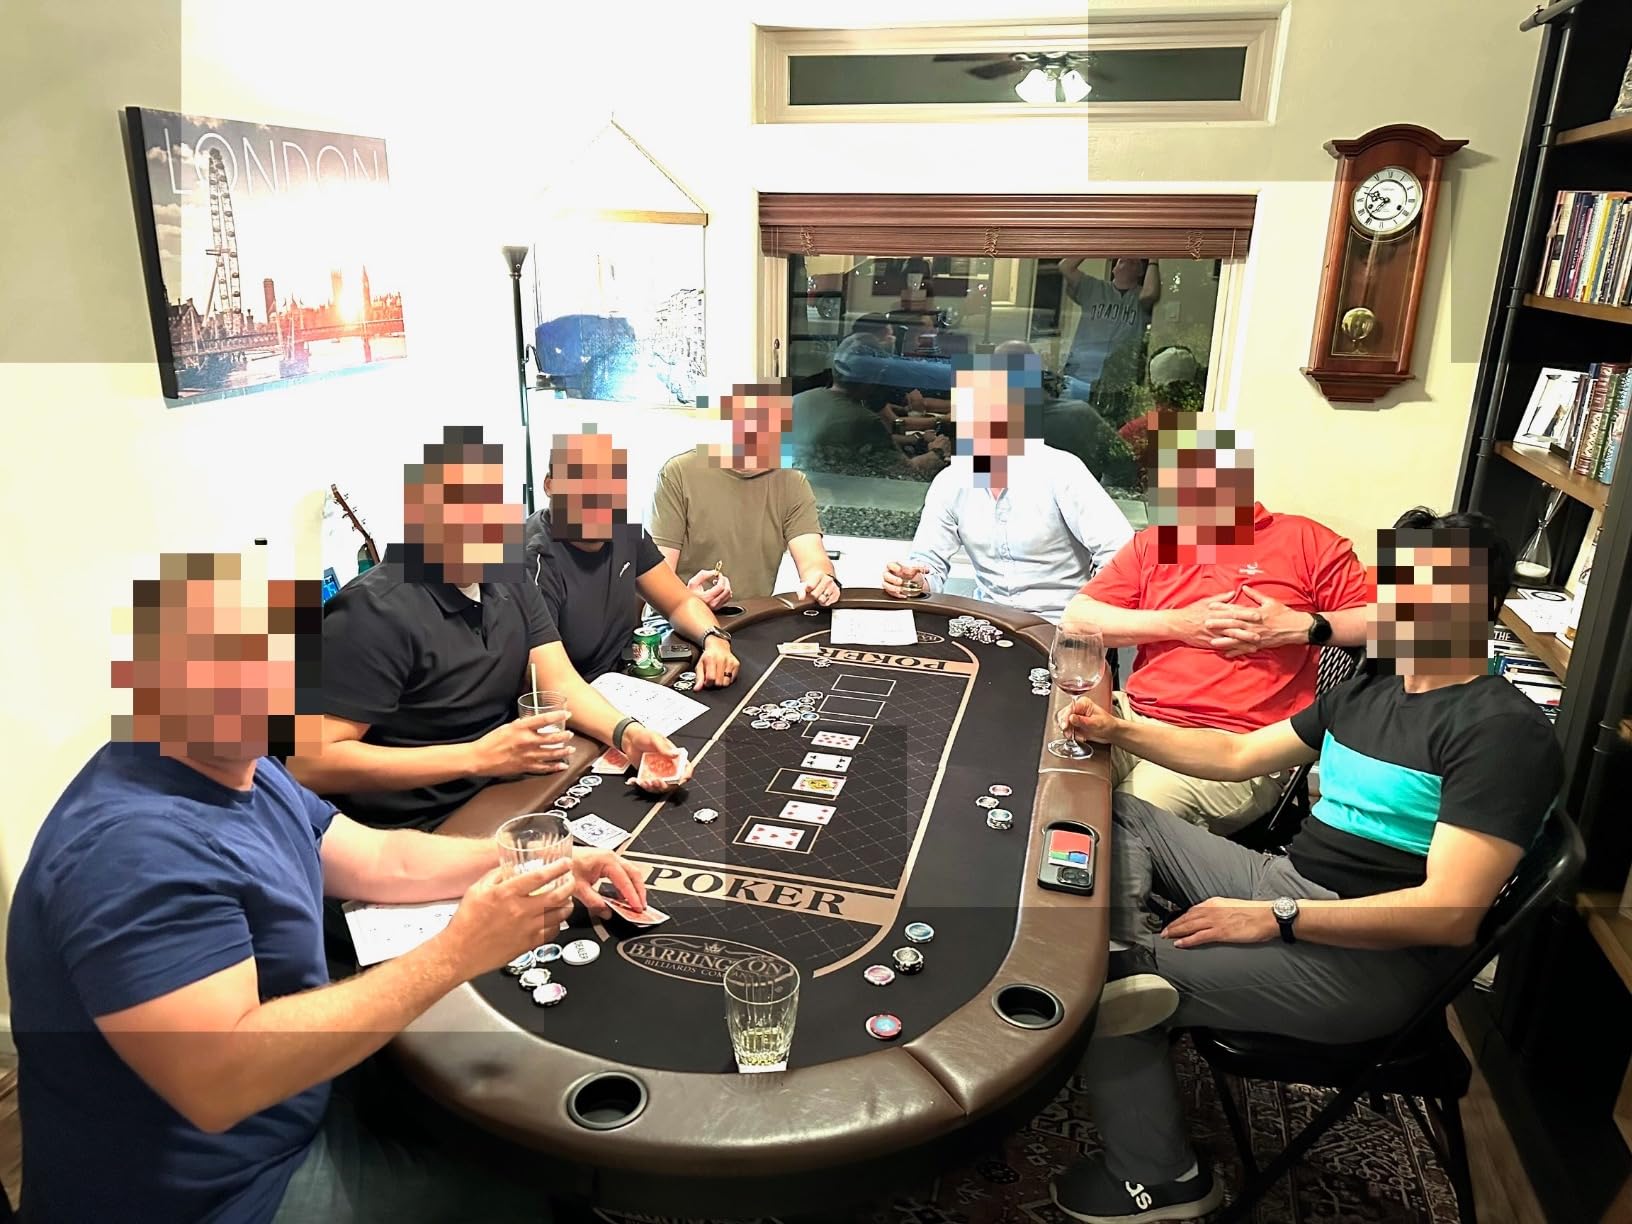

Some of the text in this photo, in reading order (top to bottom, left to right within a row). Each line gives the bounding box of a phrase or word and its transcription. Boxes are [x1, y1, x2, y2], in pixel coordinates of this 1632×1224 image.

[164, 128, 381, 196] LONDON
[818, 648, 947, 670] POKER
[644, 866, 846, 916] POKER
[644, 958, 697, 974] BILLIARDS
